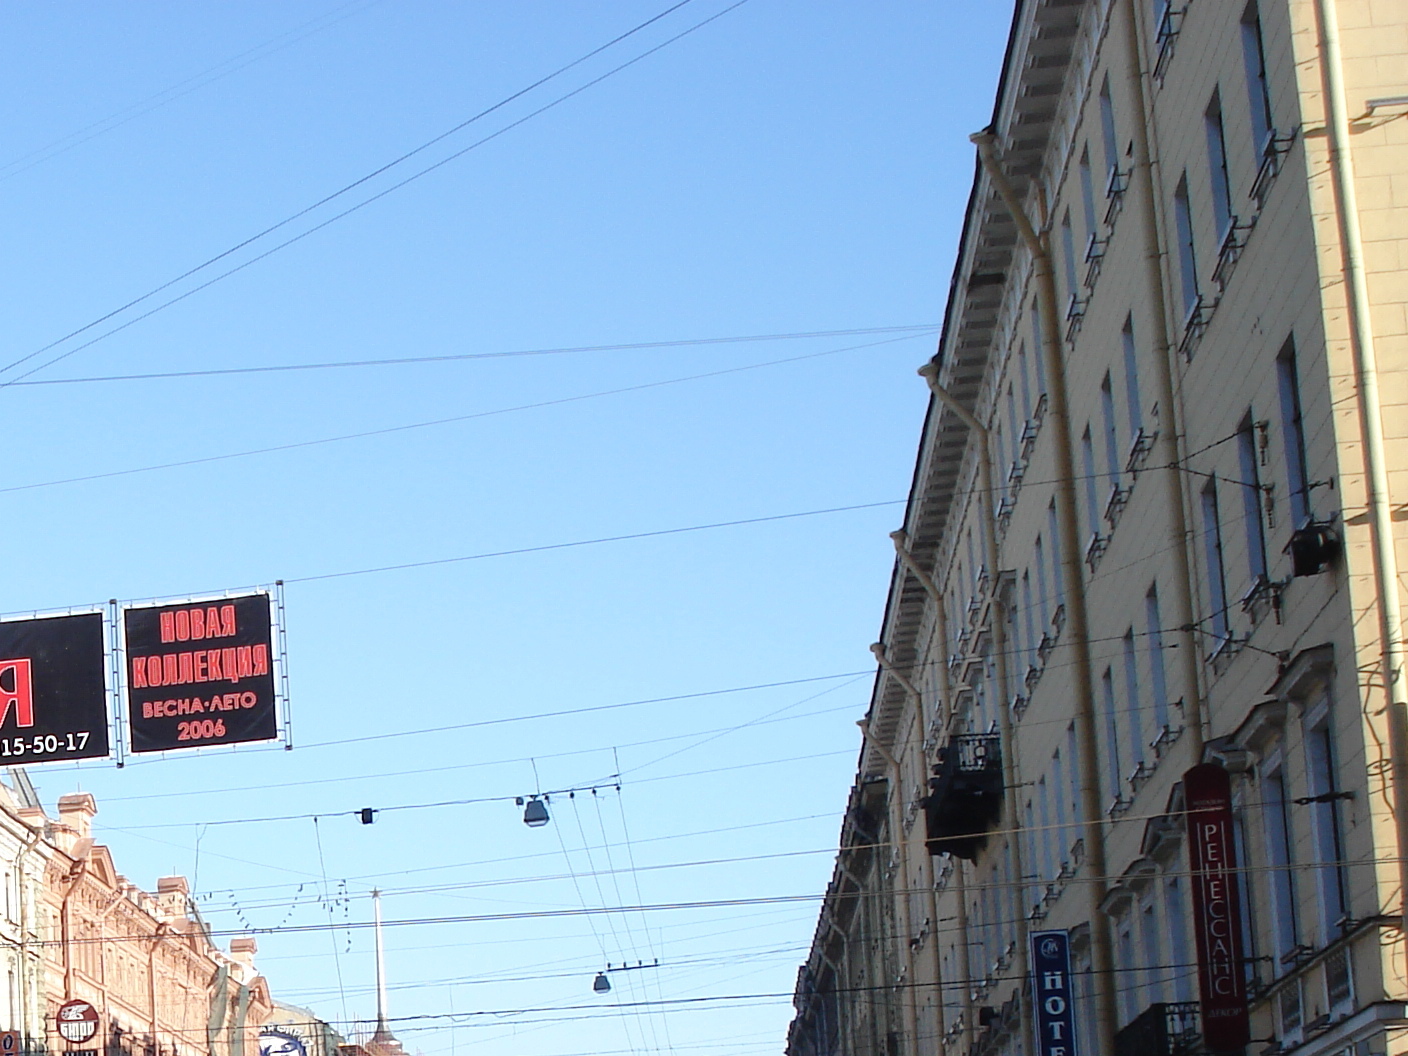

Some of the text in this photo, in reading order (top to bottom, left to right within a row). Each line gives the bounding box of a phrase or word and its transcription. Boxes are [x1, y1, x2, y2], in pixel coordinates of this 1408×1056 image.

[160, 605, 236, 643] НОВАЯ
[133, 644, 268, 688] КОЛЛЕКЦИЯ
[178, 718, 226, 741] 2006
[1205, 824, 1231, 995] РЕНЕССАНС
